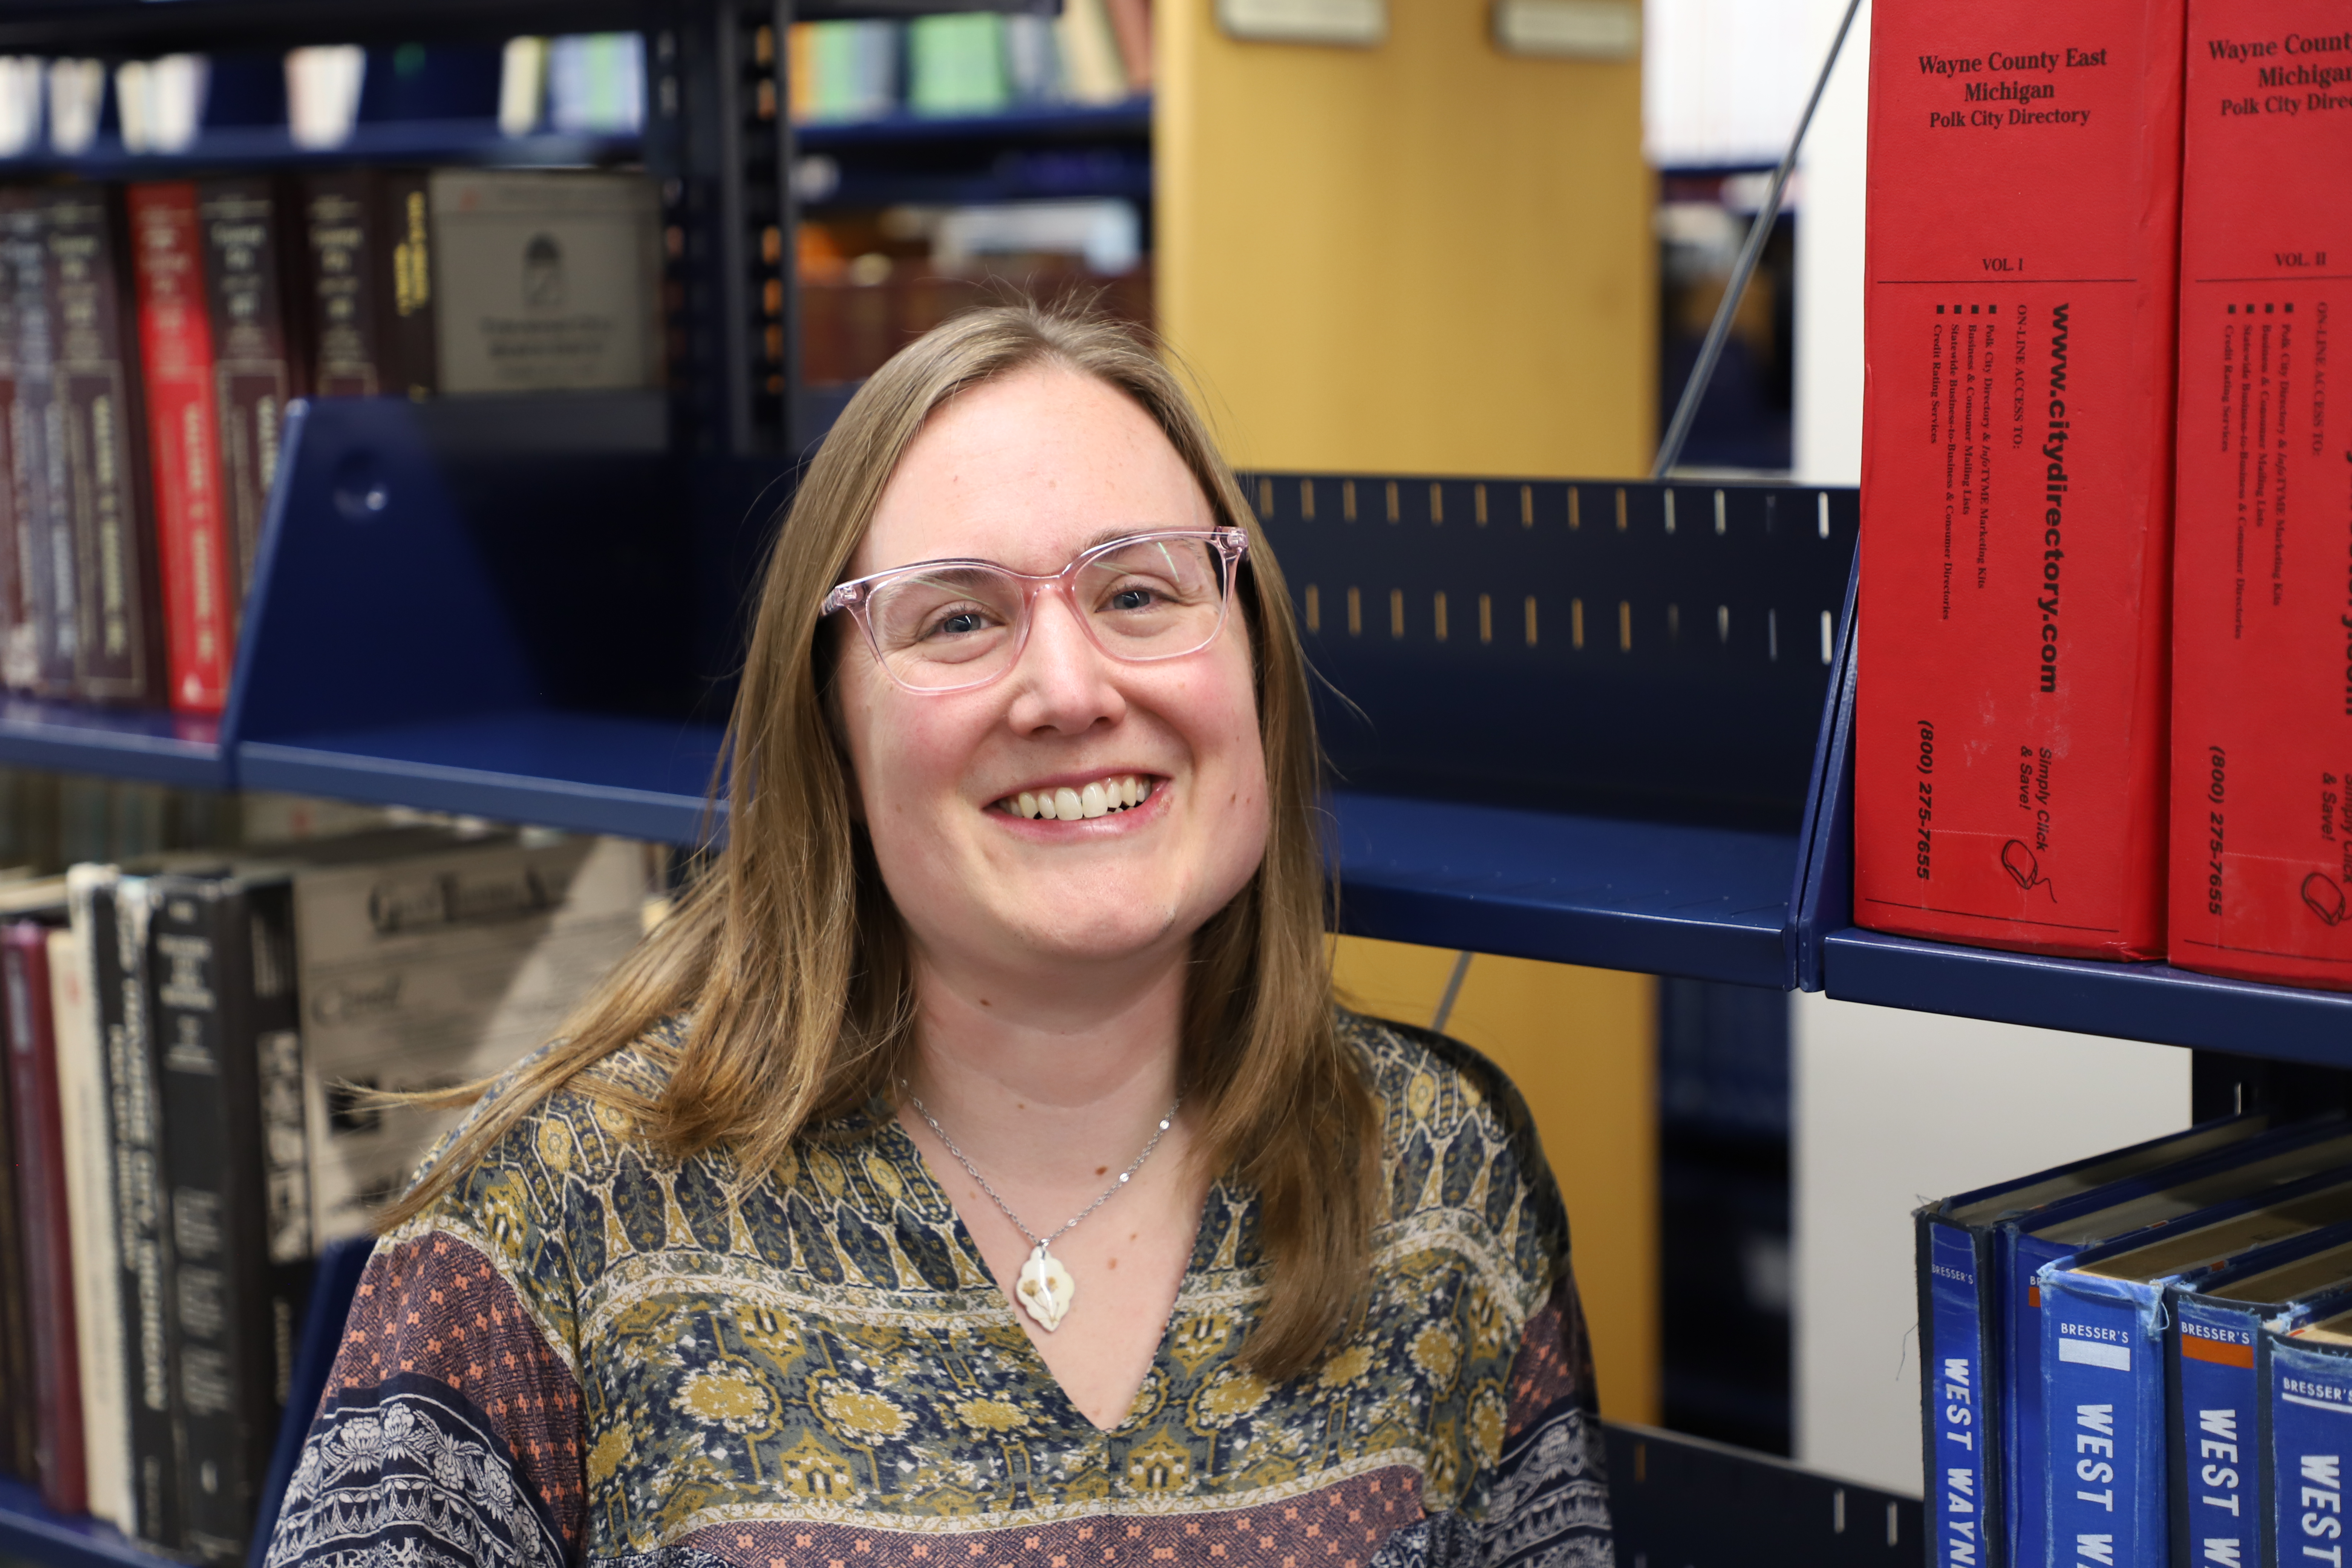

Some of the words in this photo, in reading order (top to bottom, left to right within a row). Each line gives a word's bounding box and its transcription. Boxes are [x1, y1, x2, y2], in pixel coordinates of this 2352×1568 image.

[1919, 56, 1982, 78] Wayne
[1989, 52, 2059, 73] County
[2066, 48, 2107, 67] East
[2209, 40, 2277, 63] Wayne
[2285, 32, 2352, 54] Count
[1965, 81, 2054, 104] Michigan
[2222, 98, 2259, 115] Polk
[2265, 96, 2301, 115] City
[1931, 112, 1966, 127] Polk
[1971, 110, 2003, 129] City
[2009, 107, 2090, 126] Directory
[1983, 258, 2014, 271] VOL.
[2019, 258, 2023, 271] I
[2275, 253, 2310, 266] VOL.
[2315, 252, 2326, 266] II
[1950, 325, 1959, 376] Statewide
[1968, 325, 1977, 370] Business
[1986, 325, 1994, 348] Polk
[2016, 305, 2027, 364] ON-LINE
[2224, 325, 2234, 361] Credit
[2242, 325, 2252, 379] Statewide
[2261, 325, 2272, 373] Business
[2281, 324, 2291, 349] Polk
[2315, 302, 2328, 366] ON-LINE
[1931, 362, 1941, 397] Rating
[1967, 374, 1975, 382] &
[1983, 352, 1993, 373] City
[2221, 365, 2233, 402] Rating
[2261, 377, 2270, 386] &
[2278, 353, 2290, 377] City
[1965, 387, 1974, 441] Consumer
[1981, 378, 1993, 428] Directory
[2015, 369, 2024, 421] ACCESS
[2277, 381, 2289, 434] Directory
[2314, 371, 2324, 427] ACCESS
[1931, 401, 1940, 443] Services
[1947, 380, 1958, 488] Business-to-Business
[1983, 432, 1991, 441] &
[2014, 426, 2023, 448] TO:
[2222, 406, 2231, 452] Services
[2259, 391, 2269, 449] Consumer
[2278, 439, 2287, 448] &
[1962, 446, 1973, 486] Mailing
[1980, 446, 1990, 504] InfoTYME
[2255, 453, 2267, 497] Mailing
[1946, 492, 1954, 501] &
[1963, 490, 1972, 514] Lists
[2038, 303, 2070, 692] www.citydirectory.com
[2239, 503, 2247, 512] &
[2256, 500, 2266, 527] Lists
[1945, 505, 1953, 559] Consumer
[1977, 508, 1988, 563] Marketing
[2237, 516, 2246, 574] Consumer
[2272, 519, 2285, 579] Marketing
[1943, 563, 1952, 619] Directories
[1978, 568, 1986, 588] Kits
[2273, 583, 2283, 606] Kits
[2235, 578, 2245, 639] Directories
[1917, 720, 1934, 774] (800)
[2021, 746, 2032, 757] &
[2020, 763, 2032, 810] Save!
[2035, 747, 2052, 805] Simply
[2208, 746, 2225, 804] (800)
[2323, 773, 2337, 784] &
[1917, 782, 1932, 880] 275-7655
[2037, 810, 2050, 851] Click
[2321, 792, 2337, 841] Save!
[2209, 812, 2223, 916] 275-7655
[1932, 1263, 1973, 1285] BRESSER'S
[2061, 1323, 2129, 1343] BRESSER'S
[2181, 1321, 2249, 1344] BRESSER'S
[1945, 1359, 1972, 1450] WEST
[2077, 1404, 2113, 1511] WEST
[2200, 1410, 2239, 1516] WEST
[1948, 1469, 1975, 1568] WAYN
[2301, 1456, 2341, 1568] WEST
